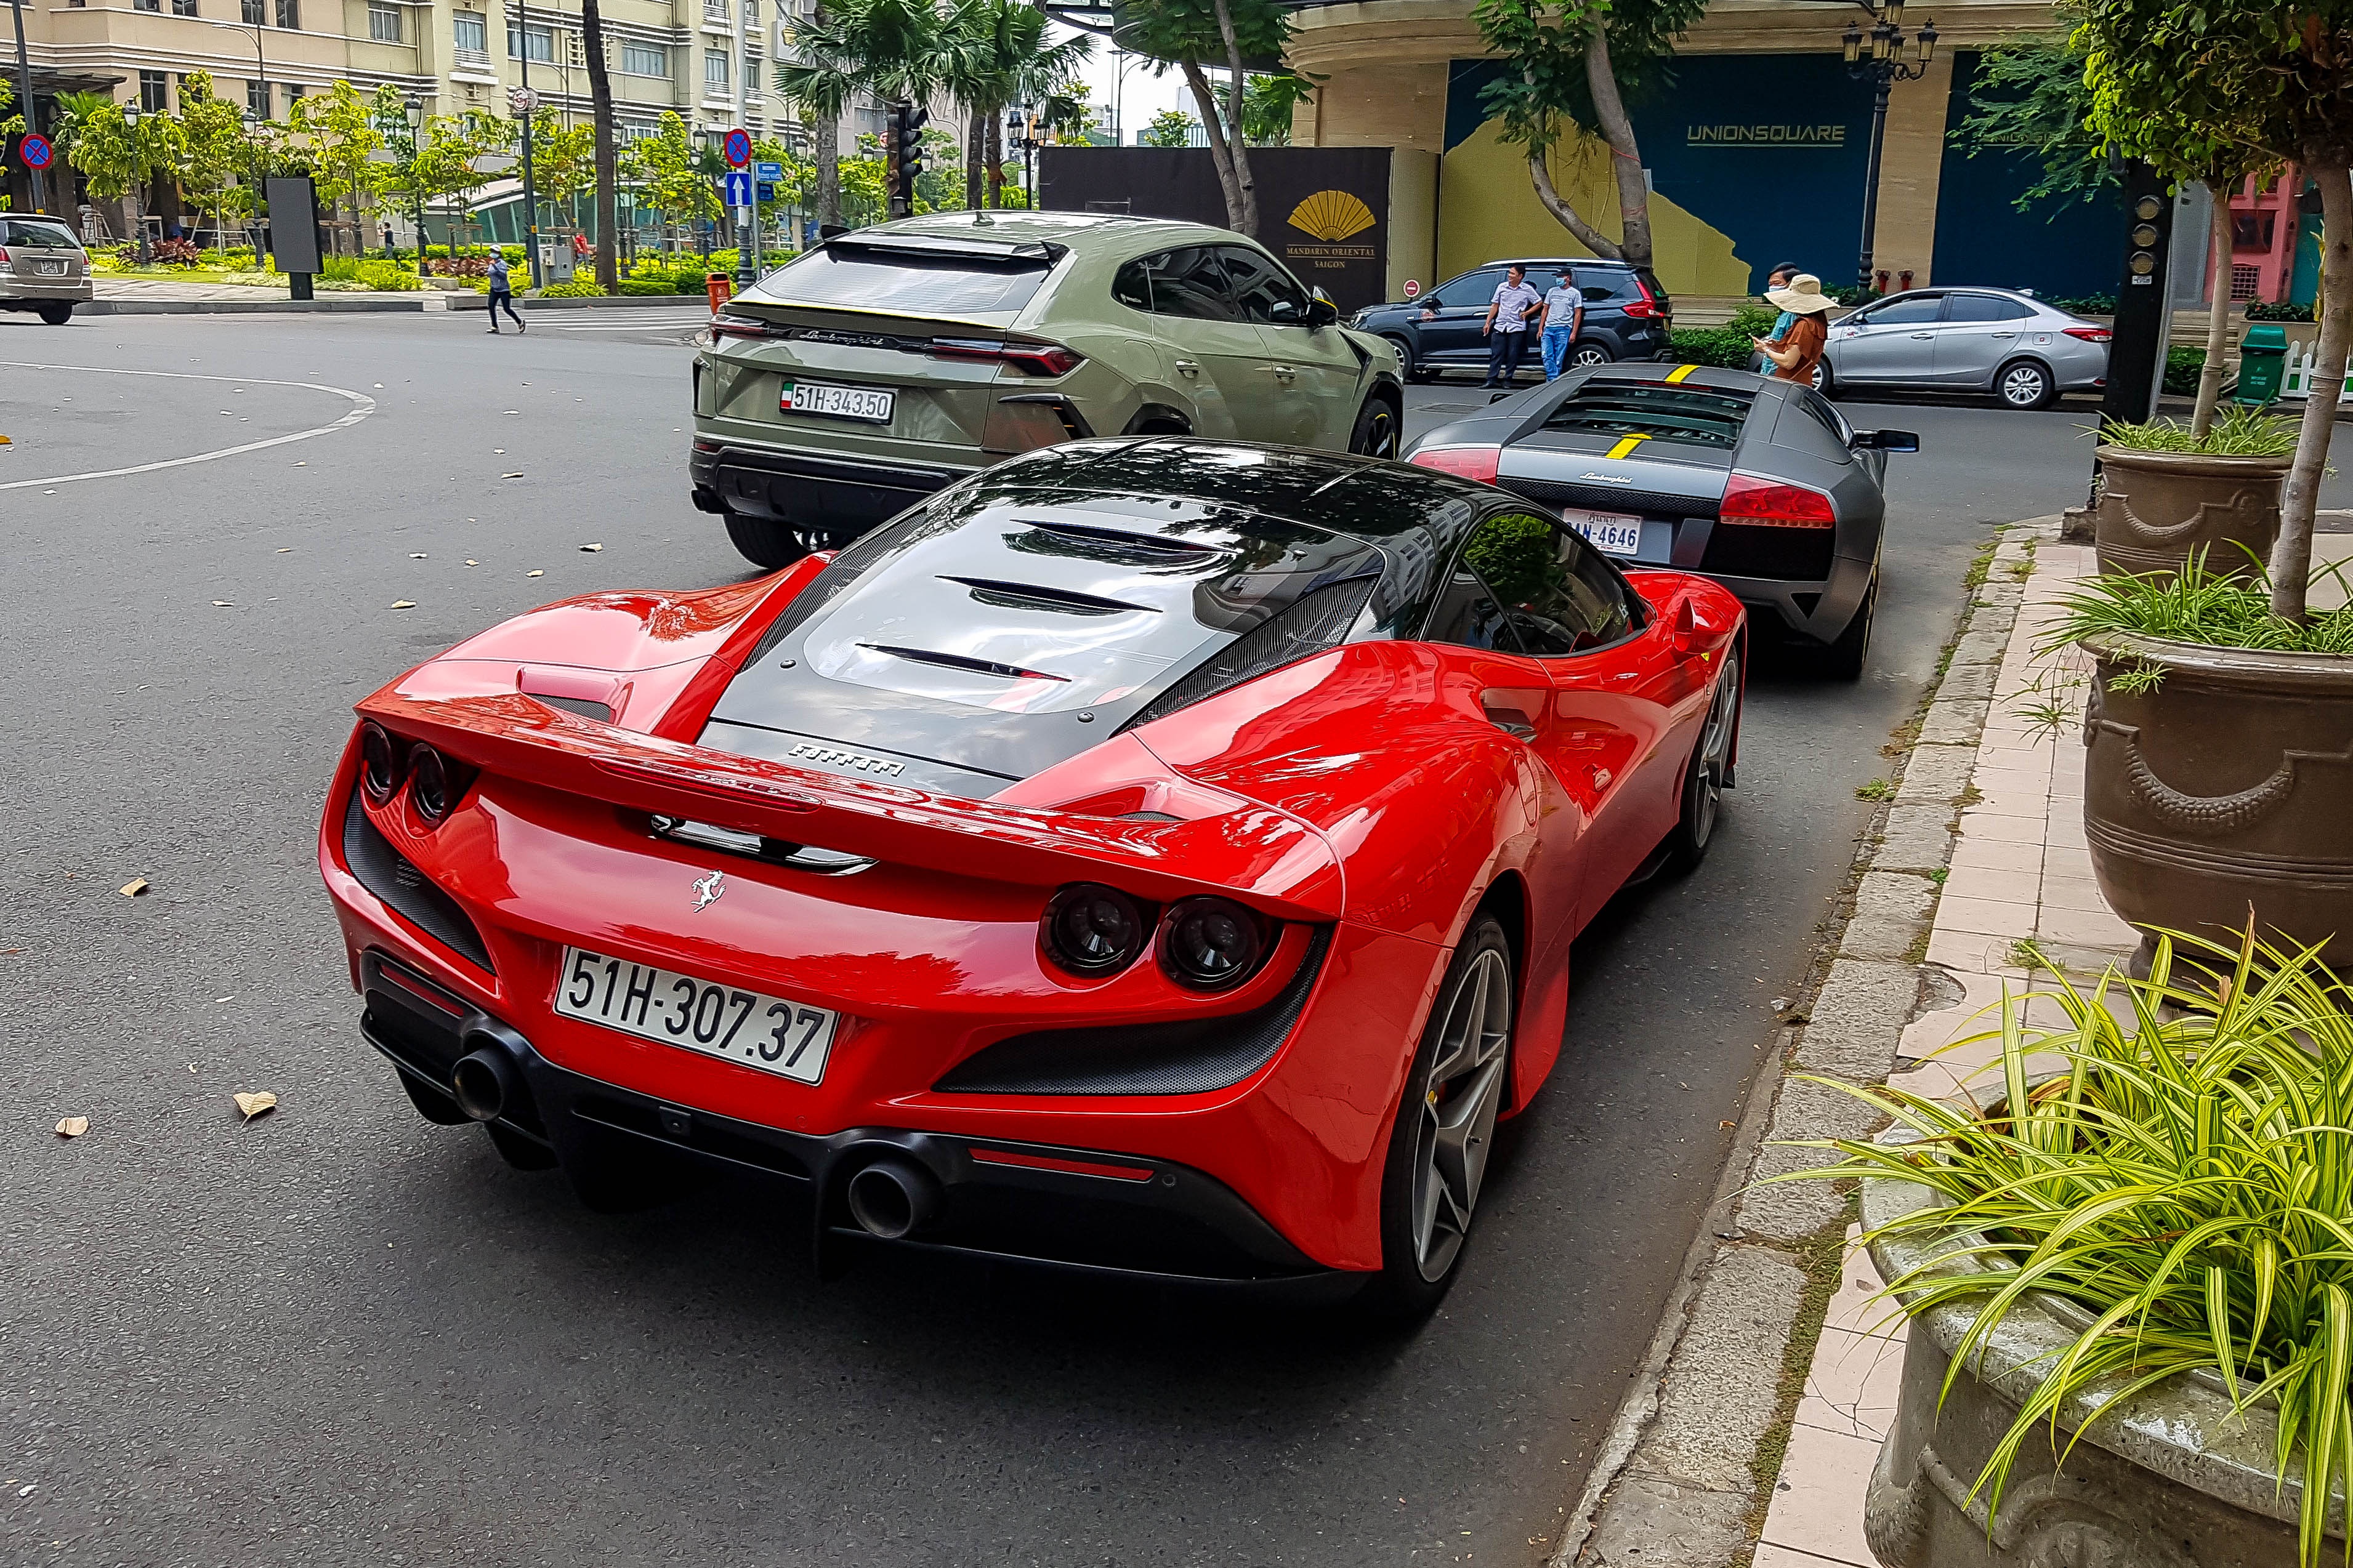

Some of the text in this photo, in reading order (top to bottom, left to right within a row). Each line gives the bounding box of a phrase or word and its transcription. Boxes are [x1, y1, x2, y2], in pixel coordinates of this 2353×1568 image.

[1687, 125, 1846, 141] UNIONSQUARE
[1286, 247, 1375, 256] MANDARIN ORIENTAL
[1315, 260, 1346, 268] SAIGON
[794, 386, 889, 417] 51H-343.50
[1579, 472, 1633, 484] Lamborghini
[788, 742, 906, 778] Ferrari
[568, 951, 825, 1067] 51H-307.37
